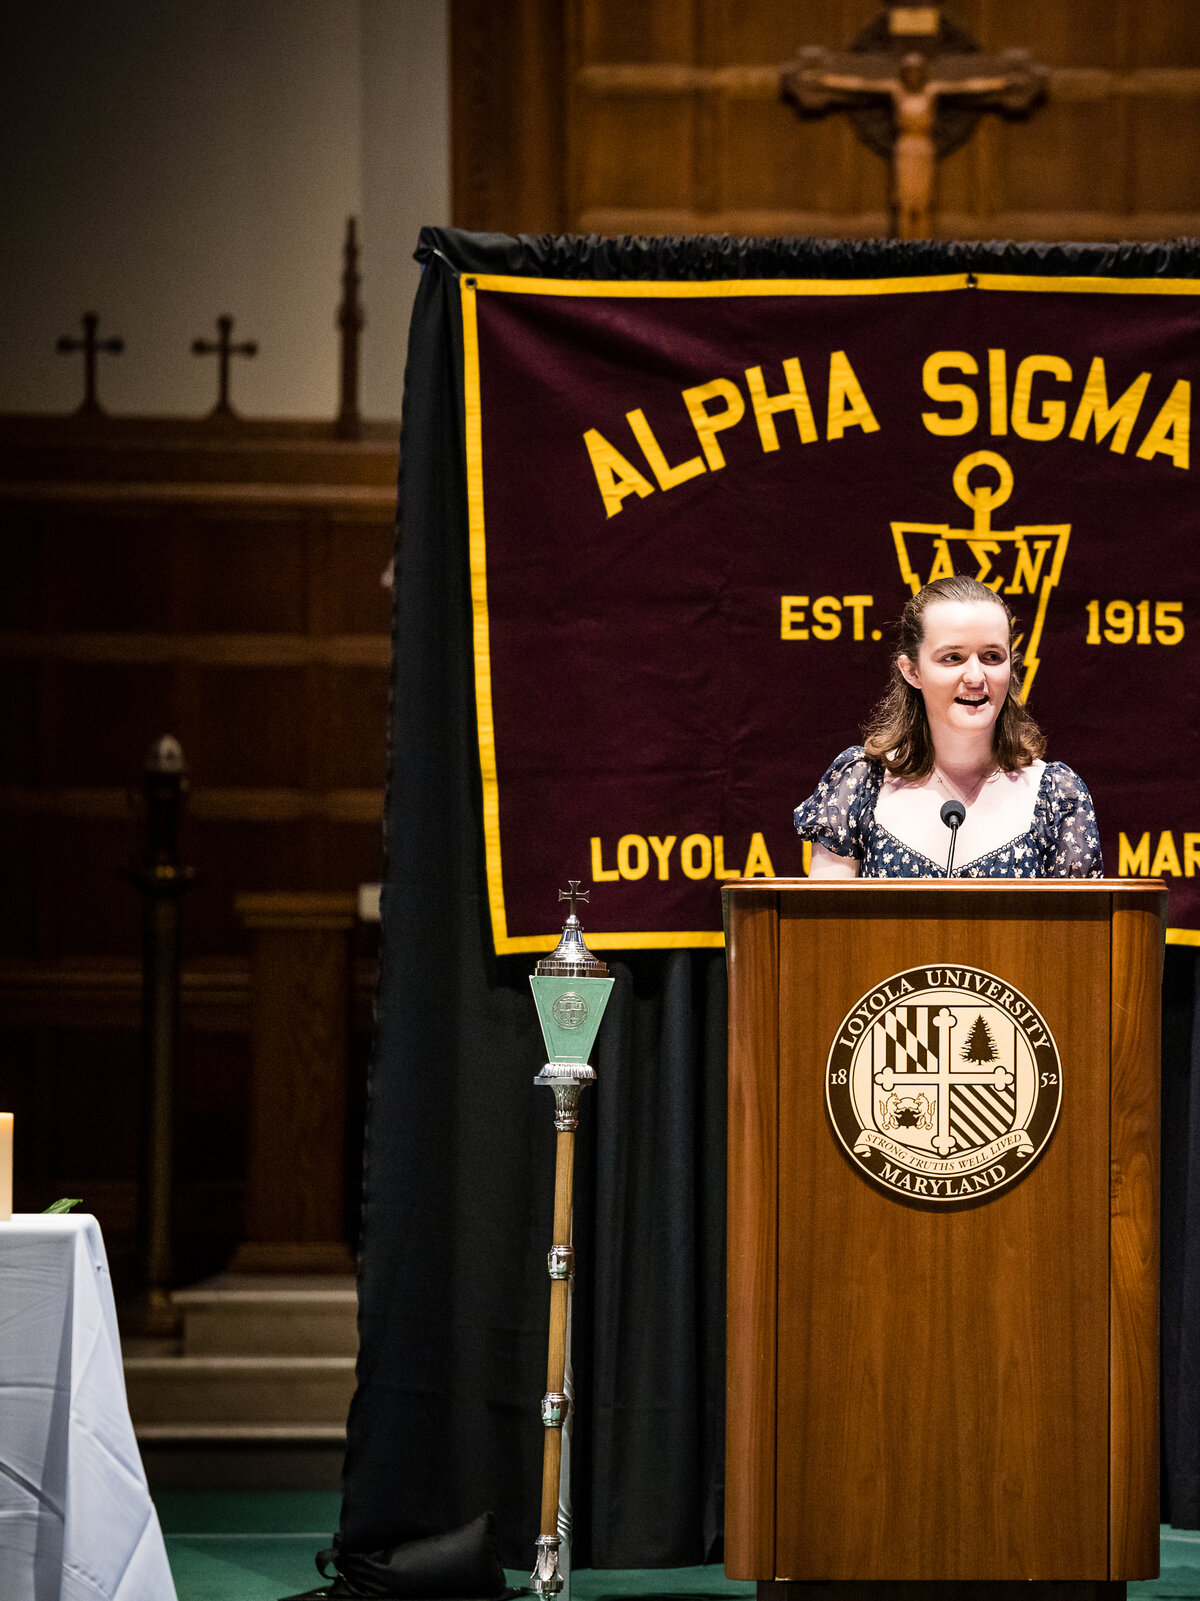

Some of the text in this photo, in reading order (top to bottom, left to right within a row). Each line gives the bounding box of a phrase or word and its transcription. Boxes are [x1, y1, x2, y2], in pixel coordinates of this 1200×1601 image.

[583, 350, 880, 518] ALPHA
[921, 348, 1191, 470] SIGMA
[780, 595, 1185, 646] EST. 1915
[590, 832, 776, 882] LOYOLA
[839, 969, 1051, 1051] LOYOLA UNIVERSITY
[830, 1068, 848, 1085] 18
[1040, 1073, 1058, 1088] 52
[865, 1133, 1022, 1171] STRONG TRUTHS WELL LIVED
[878, 1162, 1006, 1196] MARYLAND
